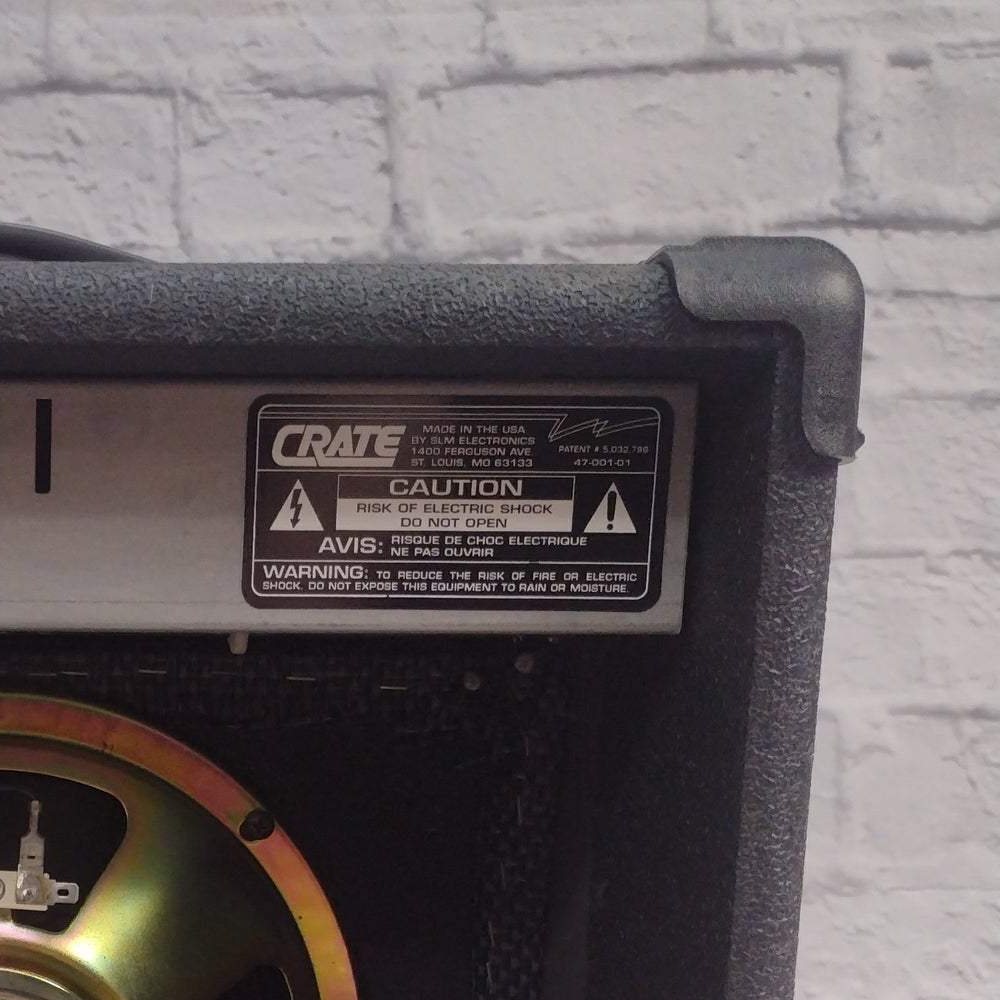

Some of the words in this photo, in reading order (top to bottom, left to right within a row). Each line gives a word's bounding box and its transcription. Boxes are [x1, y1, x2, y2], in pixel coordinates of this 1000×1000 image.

[423, 425, 456, 433] MADE
[502, 426, 525, 434] USA
[272, 424, 406, 467] CRATE
[411, 436, 426, 444] BY
[430, 436, 455, 444] SLM
[459, 437, 535, 445] ELECTRONICS
[445, 448, 506, 456] FERGUSON
[509, 448, 531, 456] AVE
[472, 459, 491, 467] MO
[494, 459, 533, 467] 63133
[574, 459, 631, 467] 47-001-01
[389, 479, 523, 497] CAUTION
[357, 503, 391, 513] RISK
[398, 504, 417, 513] OF
[424, 504, 494, 514] ELECTRIC
[500, 504, 552, 514] SHOCK
[401, 518, 422, 527] DO
[428, 518, 458, 528] NOT
[466, 518, 507, 528] OPEN
[318, 537, 383, 554] AVIS:
[391, 536, 439, 545] RISQUE
[445, 536, 462, 545] DE
[467, 536, 504, 545] CHOC
[509, 537, 587, 547] ELECTRIQUE
[391, 548, 409, 556] NE
[414, 548, 440, 557] PAS
[444, 548, 494, 557] OUVRIR
[263, 565, 368, 579] WARNING:
[377, 571, 390, 579] TO
[398, 571, 442, 580] REDUCE
[450, 572, 471, 580] THE
[478, 572, 504, 581] RISK
[512, 572, 525, 581] OF
[533, 572, 556, 581] FIRE
[564, 572, 579, 581] OR
[586, 573, 637, 582] ELECTRIC
[308, 582, 324, 590] DO
[329, 583, 350, 591] NOT
[355, 583, 398, 591] EXPOSE
[402, 583, 427, 591] THIS
[431, 583, 497, 592] EQUIPMENT
[502, 583, 516, 592] TO
[519, 584, 547, 592] RAIN
[551, 584, 565, 592] OR
